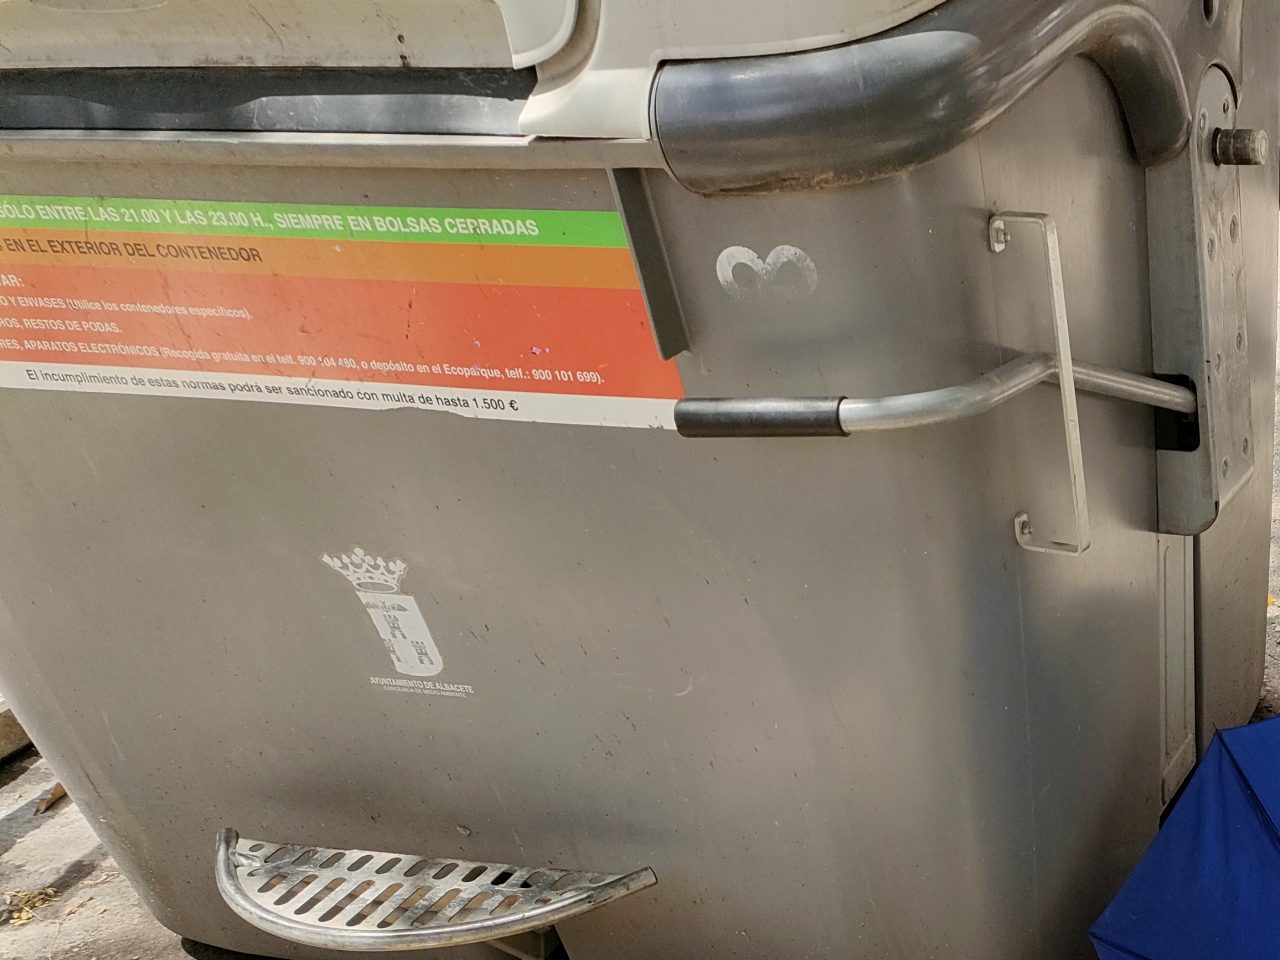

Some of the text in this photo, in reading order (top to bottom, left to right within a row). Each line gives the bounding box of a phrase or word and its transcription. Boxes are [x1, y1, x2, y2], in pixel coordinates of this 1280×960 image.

[36, 205, 88, 221] ENTRE
[88, 206, 120, 222] LAS
[121, 208, 160, 223] 21.00
[160, 208, 172, 224] Y
[174, 209, 208, 225] LAS
[208, 211, 249, 227] 23.00
[273, 213, 344, 230] SIEMPRE
[347, 215, 373, 231] EN
[373, 216, 442, 233] BOLSAS
[444, 217, 540, 236] CERRADAS
[3, 238, 263, 262] EN EL EXTERIOR DEL CONTENEDOR
[8, 296, 17, 307] Y
[18, 297, 66, 309] ENVASES
[120, 303, 188, 315] contenedores
[22, 318, 65, 330] RESTOS
[65, 321, 82, 331] DE
[81, 321, 123, 333] PODAS.
[23, 340, 78, 352] APARATOS
[77, 343, 160, 357] ELECTRÓNICOS
[297, 355, 317, 367] 900
[417, 364, 431, 374] en
[432, 363, 442, 374] el
[443, 363, 505, 380] Ecoparque,
[531, 368, 553, 381] 900
[554, 370, 574, 382] 101
[26, 369, 519, 412] El incumplimiento de estas normas podrá ser sancionado con multa de hasta 1.500 €
